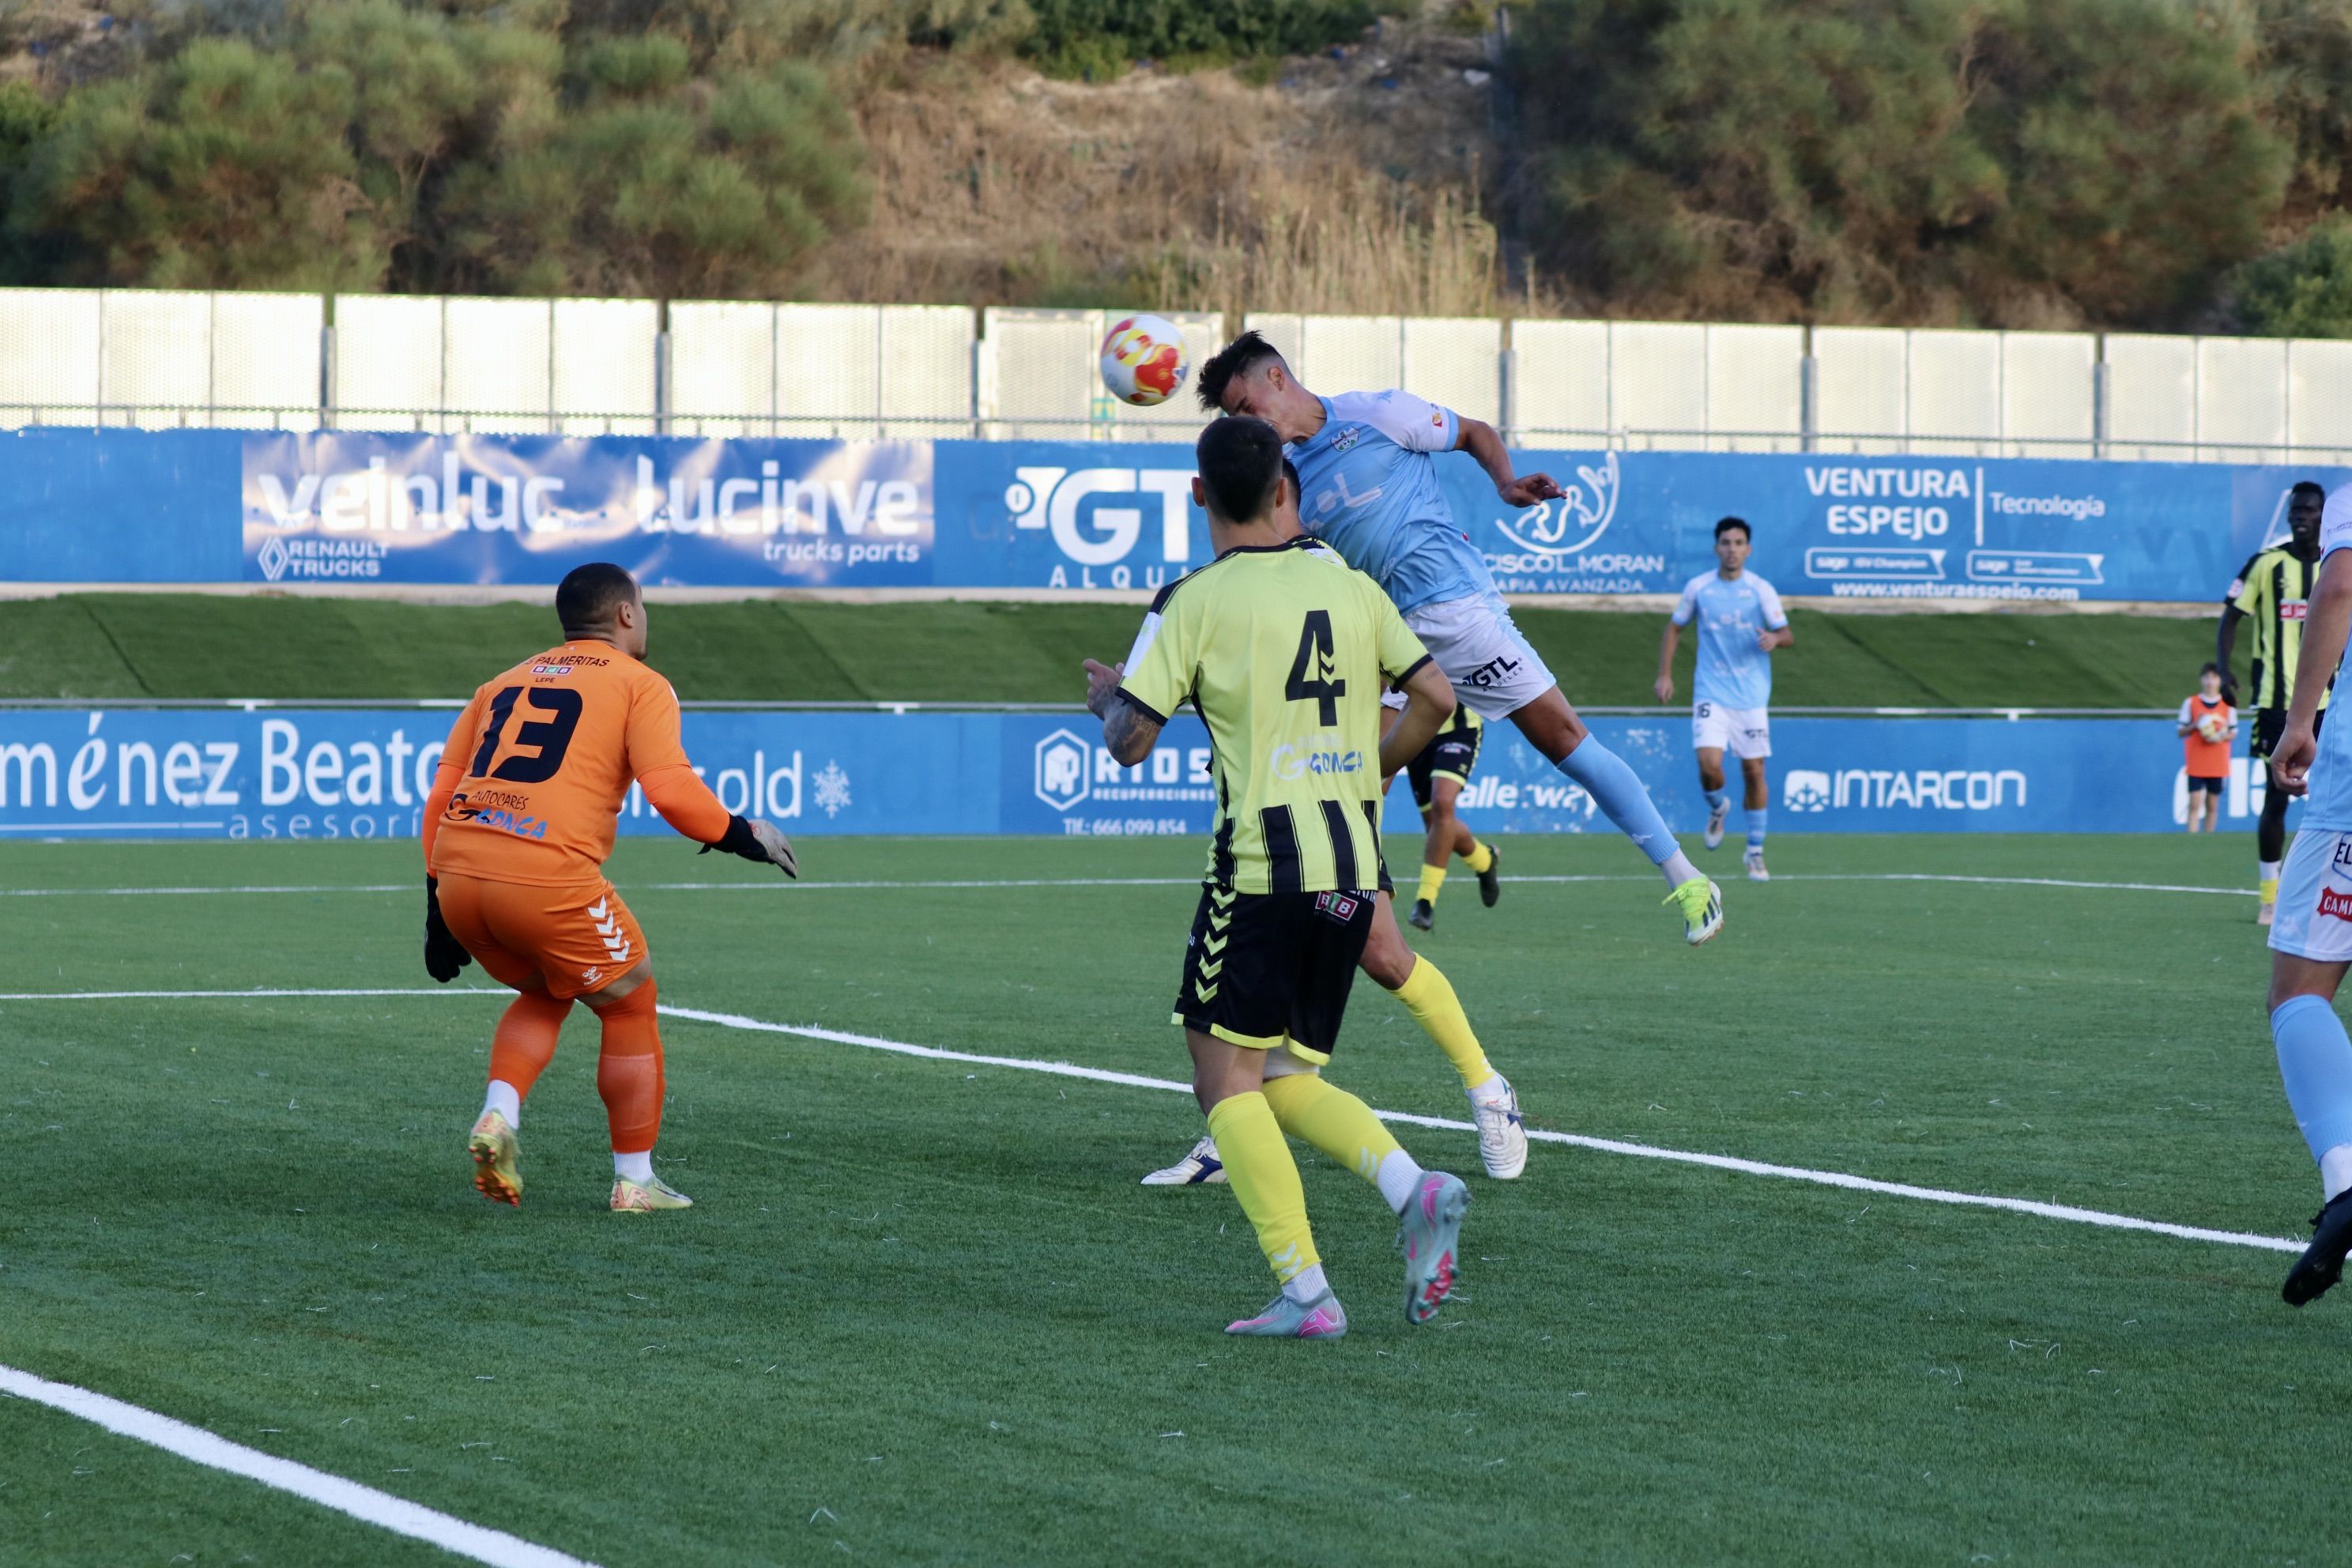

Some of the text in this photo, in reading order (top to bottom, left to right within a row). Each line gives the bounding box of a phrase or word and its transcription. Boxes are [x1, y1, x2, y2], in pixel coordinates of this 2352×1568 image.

[1805, 467, 1970, 498] VENTURA
[1988, 492, 2105, 522] Tecnología
[1827, 505, 1950, 541] ESPEJO
[289, 541, 390, 557] RENAULT
[763, 540, 920, 567] trucks parts
[290, 560, 380, 577] TRUCKS
[535, 655, 610, 667] PALMERITAS
[1285, 609, 1345, 726] 4
[468, 686, 583, 783] 13
[473, 790, 530, 811] AUTOCARES
